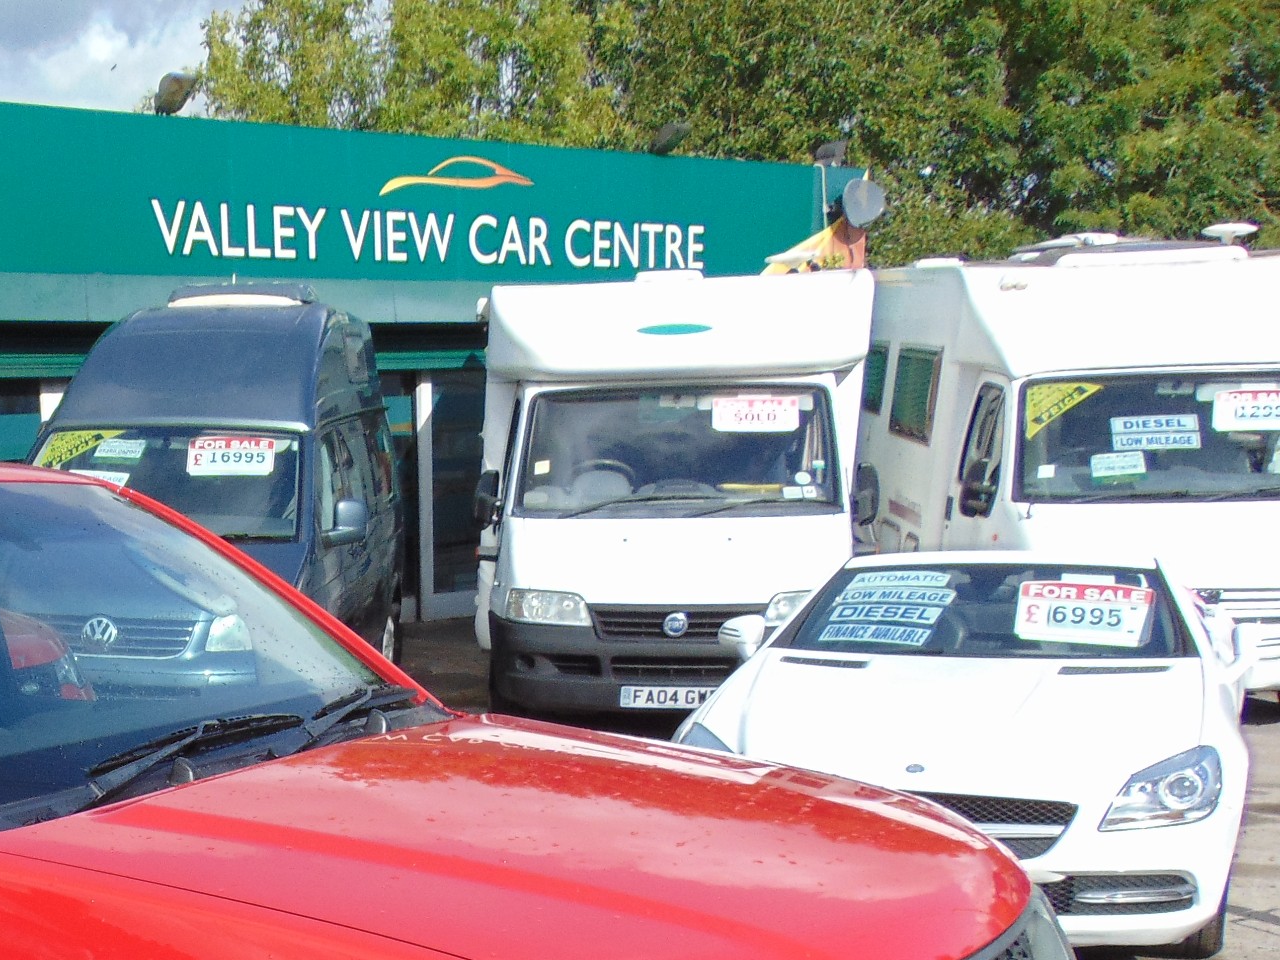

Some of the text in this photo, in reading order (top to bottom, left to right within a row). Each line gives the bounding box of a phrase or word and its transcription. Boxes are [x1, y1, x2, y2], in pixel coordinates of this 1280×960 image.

[151, 199, 704, 269] VALLEY VIEW CAR CENTRE
[734, 412, 776, 422] SOLD
[1123, 419, 1186, 429] DIESEL
[195, 440, 269, 449] FOR SALE
[1121, 436, 1193, 446] LOW MILEAGE
[210, 452, 266, 464] 16995
[855, 574, 946, 584] AUTOMATIC
[842, 590, 951, 602] LOW MILEAGE
[1028, 585, 1146, 602] FOR SALE
[836, 606, 931, 621] DIESEL
[822, 625, 928, 643] FINANCE AVAILABLE
[632, 689, 679, 704] FA04
